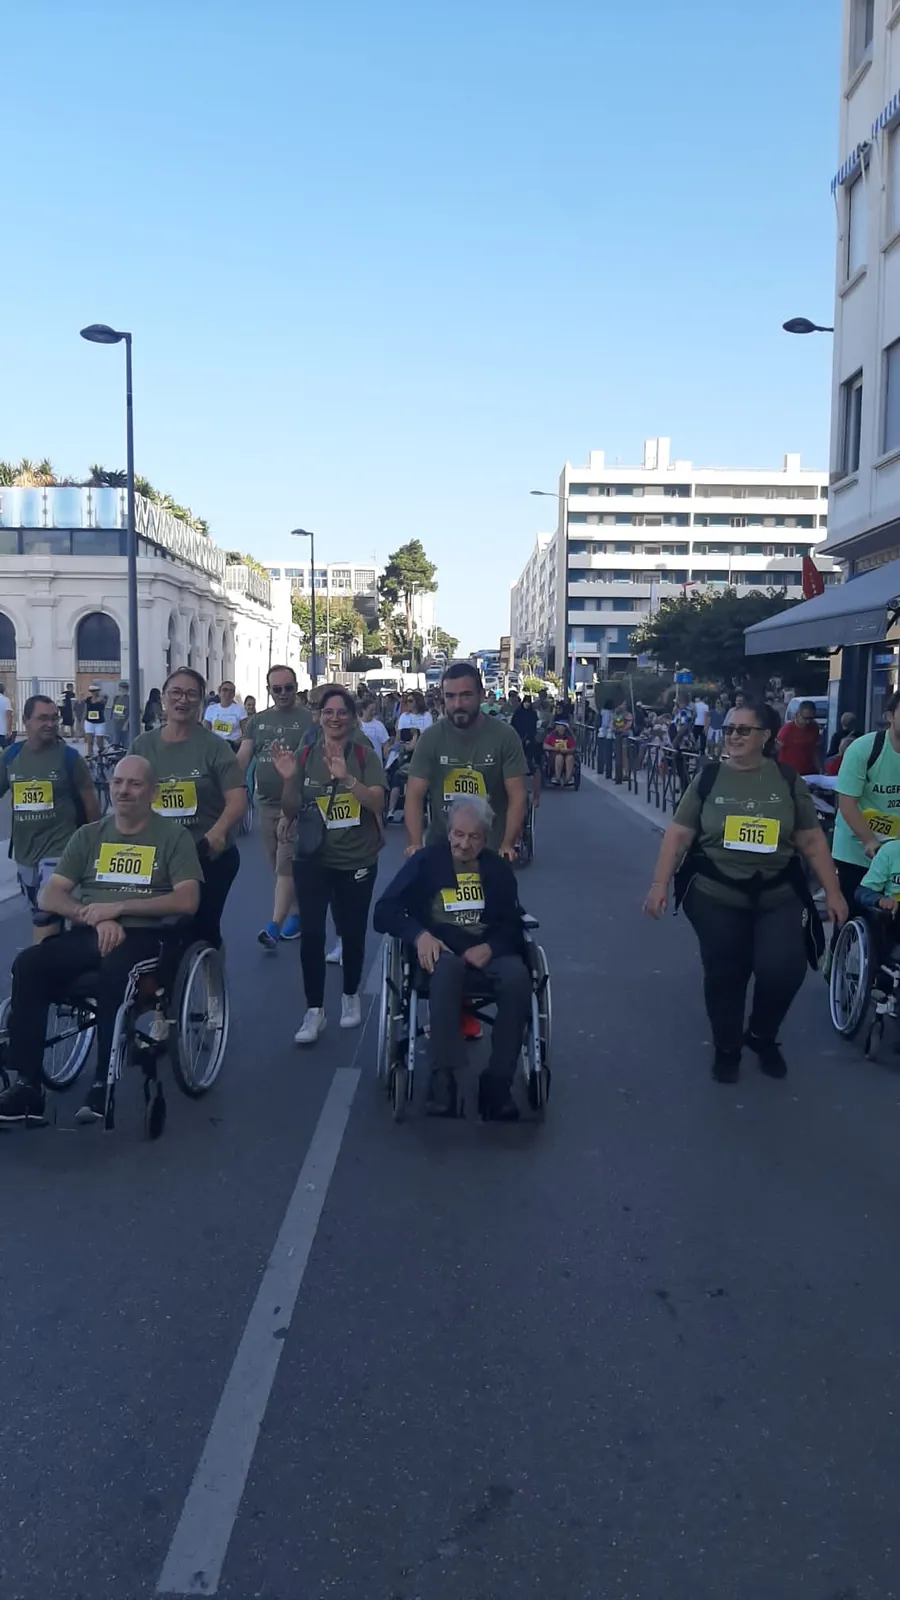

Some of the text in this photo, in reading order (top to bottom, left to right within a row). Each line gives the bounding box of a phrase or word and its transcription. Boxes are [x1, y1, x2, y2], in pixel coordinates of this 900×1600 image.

[22, 791, 45, 804] 3942
[162, 794, 184, 808] 5118
[739, 828, 764, 844] 5115
[109, 857, 142, 874] 5600
[456, 886, 483, 901] 5601
